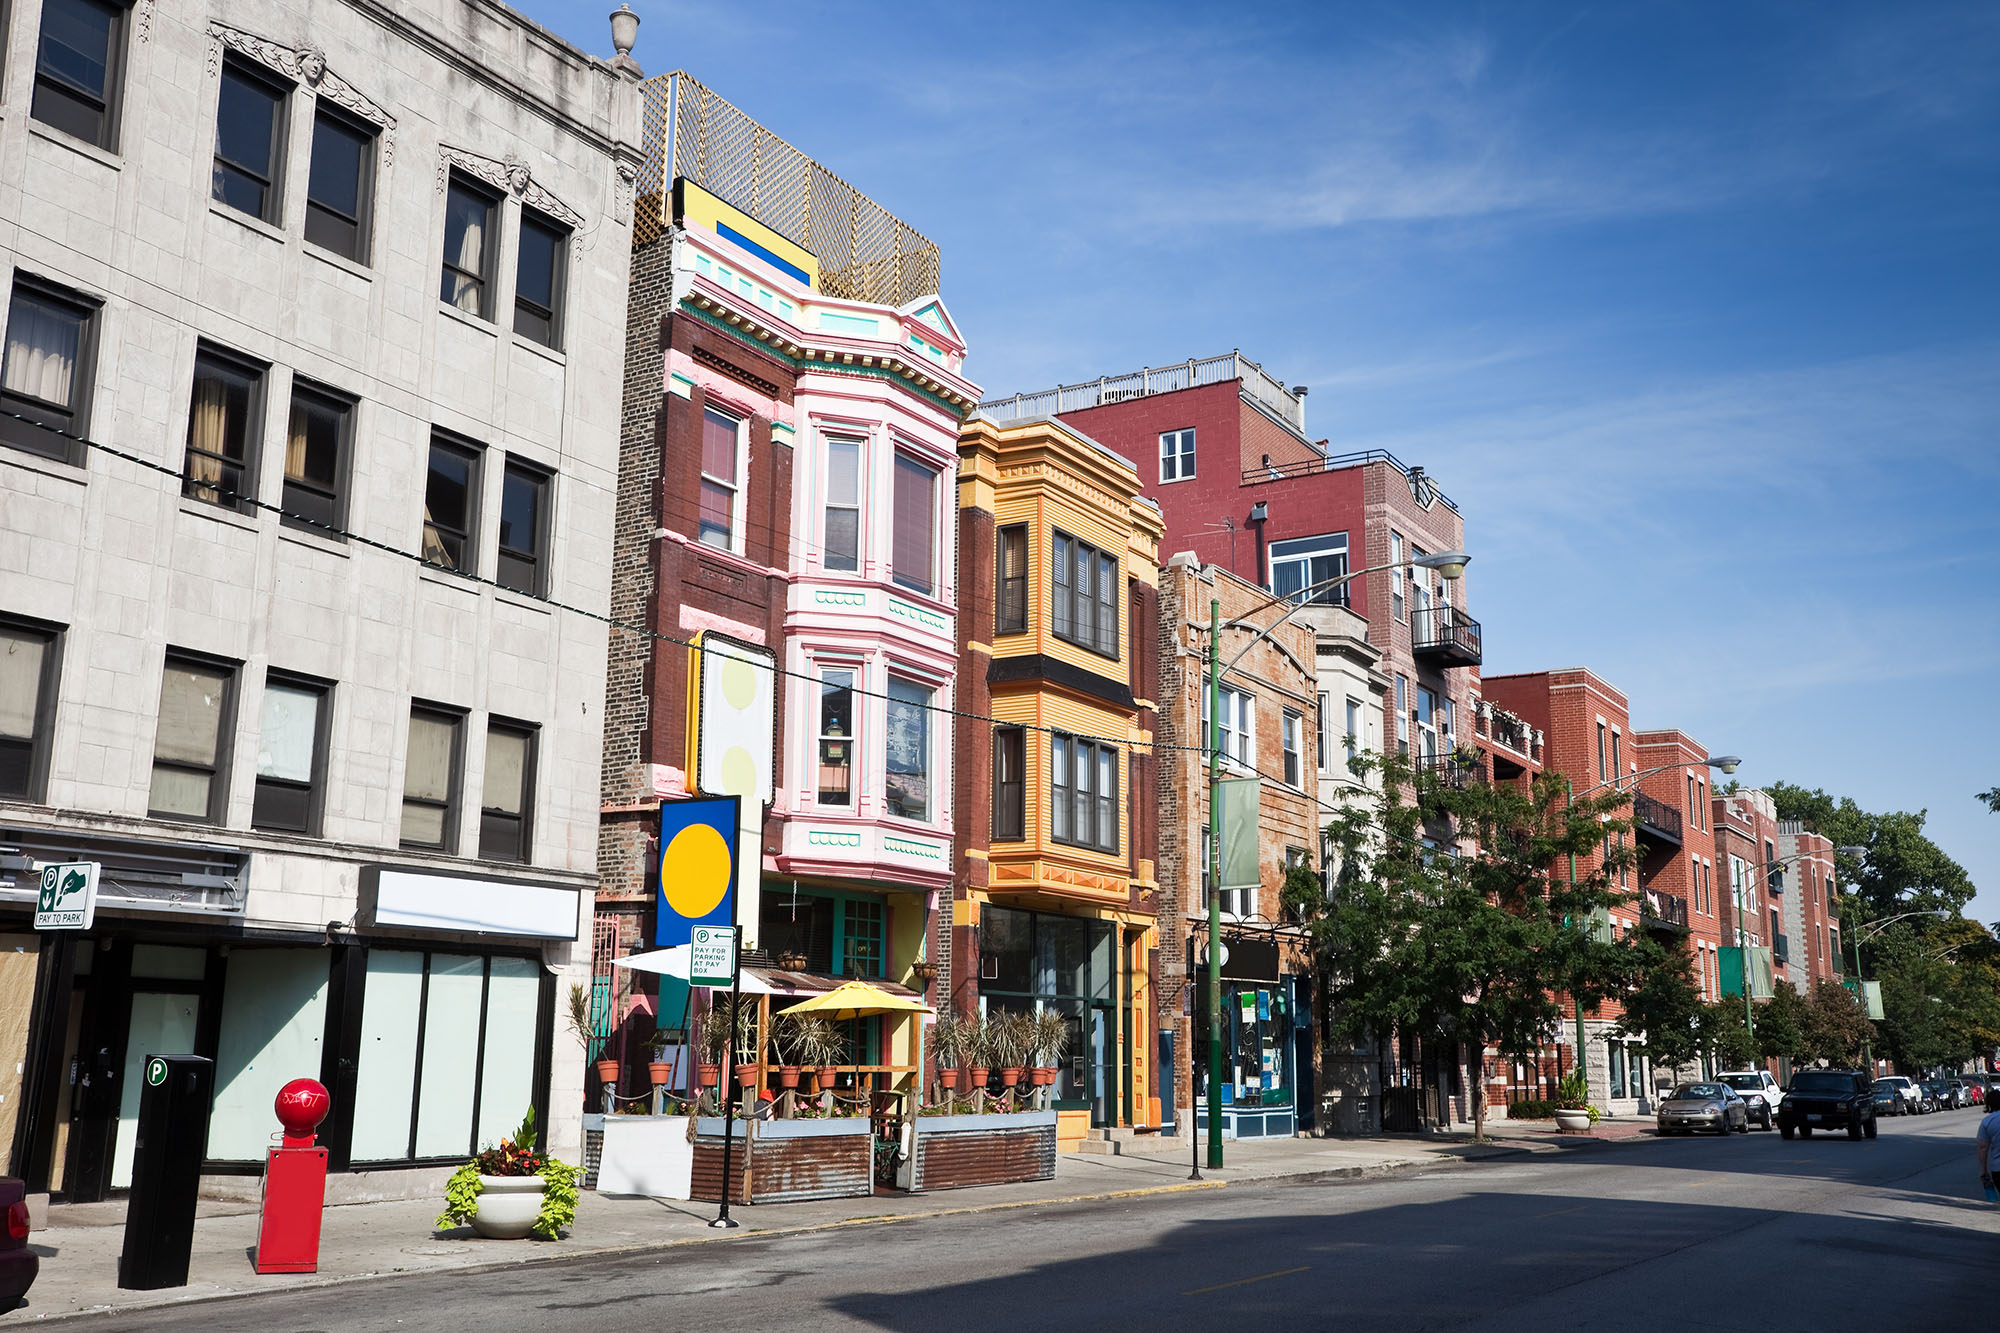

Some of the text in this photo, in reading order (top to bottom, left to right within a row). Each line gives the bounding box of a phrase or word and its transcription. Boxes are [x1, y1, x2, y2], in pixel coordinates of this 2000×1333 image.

[47, 872, 54, 886] P
[39, 913, 82, 923] PAY TO PARK
[700, 932, 707, 940] P
[152, 1063, 162, 1081] P
